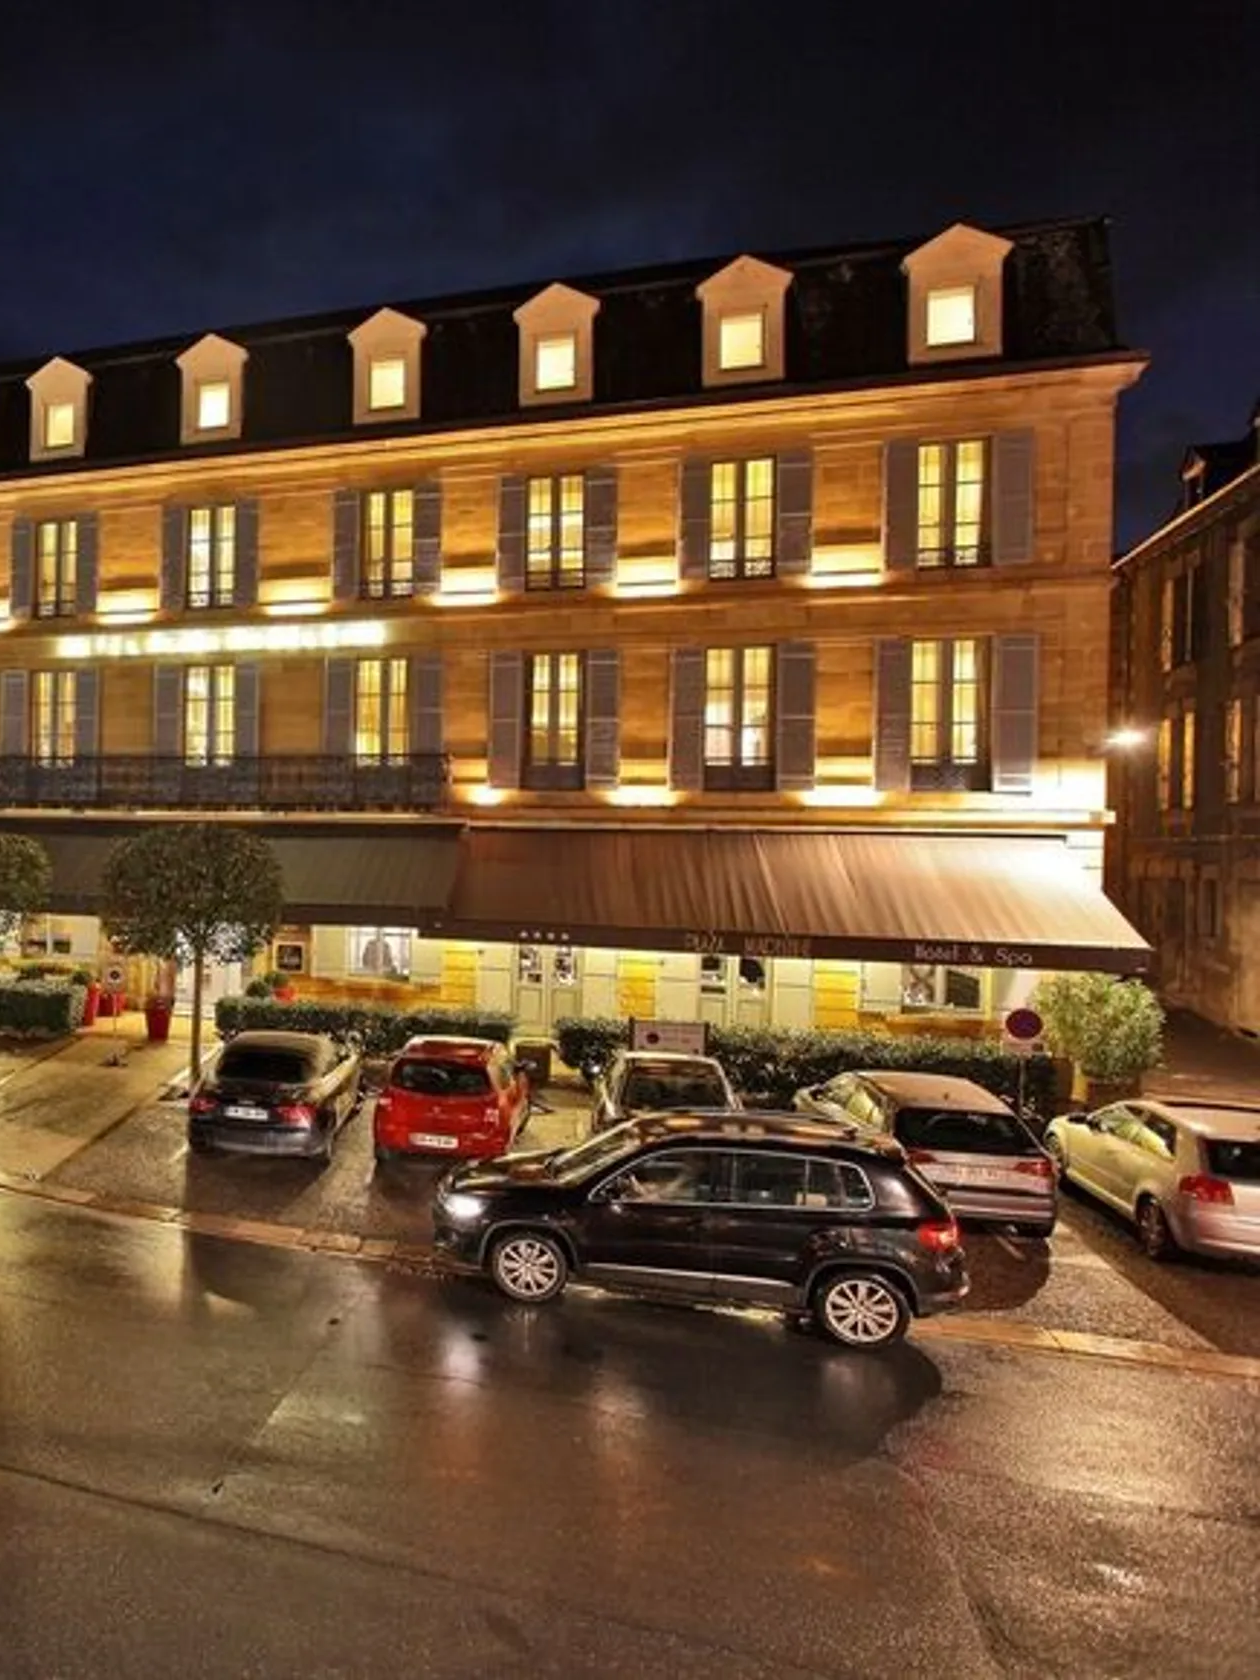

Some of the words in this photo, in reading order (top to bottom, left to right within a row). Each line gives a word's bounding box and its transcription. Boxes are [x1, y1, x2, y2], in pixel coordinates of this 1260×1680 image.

[914, 943, 960, 962] Hotel
[969, 945, 984, 963] &
[995, 947, 1034, 966] Spa
